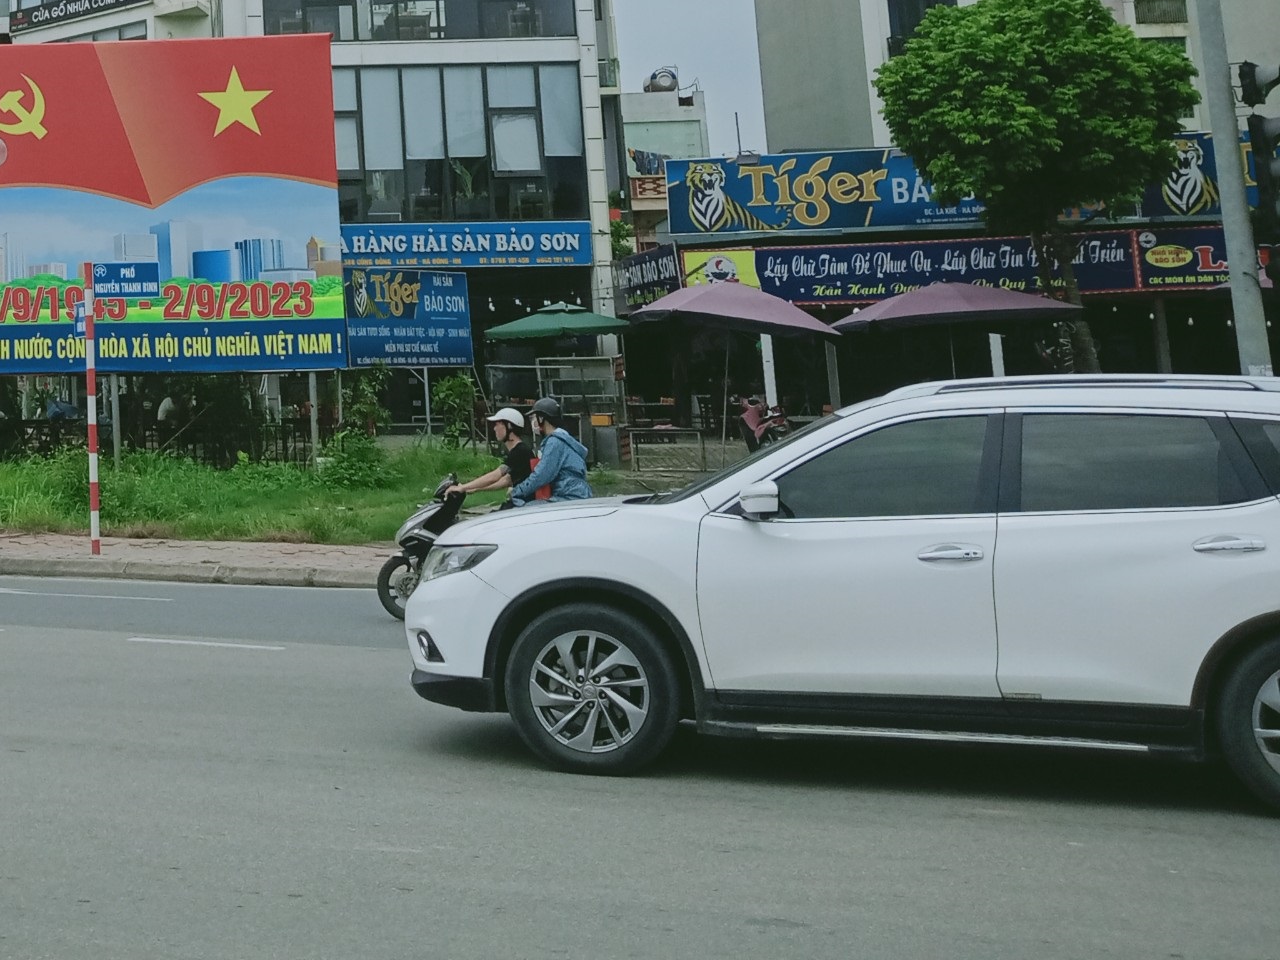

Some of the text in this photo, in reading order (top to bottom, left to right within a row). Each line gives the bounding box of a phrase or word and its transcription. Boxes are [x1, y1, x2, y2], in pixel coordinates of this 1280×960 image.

[31, 6, 50, 23] CỬA
[51, 0, 67, 19] GỖ
[66, 0, 91, 15] NHỰA
[738, 156, 888, 226] Tiger
[891, 168, 936, 204] BẢ
[352, 230, 408, 253] HÀNG
[411, 227, 447, 253] HẢI
[451, 227, 491, 253] SẢN
[495, 226, 535, 252] BẢO
[539, 231, 580, 252] SƠN
[1089, 239, 1126, 264] Triển
[120, 264, 136, 279] PHỐ
[791, 254, 816, 277] Chữ
[941, 248, 968, 275] Lấy
[970, 247, 997, 270] Chữ
[120, 281, 142, 293] THANH
[161, 280, 317, 322] 2/9/2023
[370, 271, 421, 317] Tiger
[423, 289, 466, 312] BẢO SƠN
[13, 332, 53, 360] NƯỚC
[56, 333, 86, 364] CỘN
[98, 331, 129, 359] HÒA
[131, 331, 152, 358] XÃ
[155, 330, 179, 363] HỘI
[182, 327, 212, 358] CHỦ
[215, 330, 261, 357] NGHĨA
[263, 330, 294, 360] VIỆT
[298, 332, 333, 355] NAM
